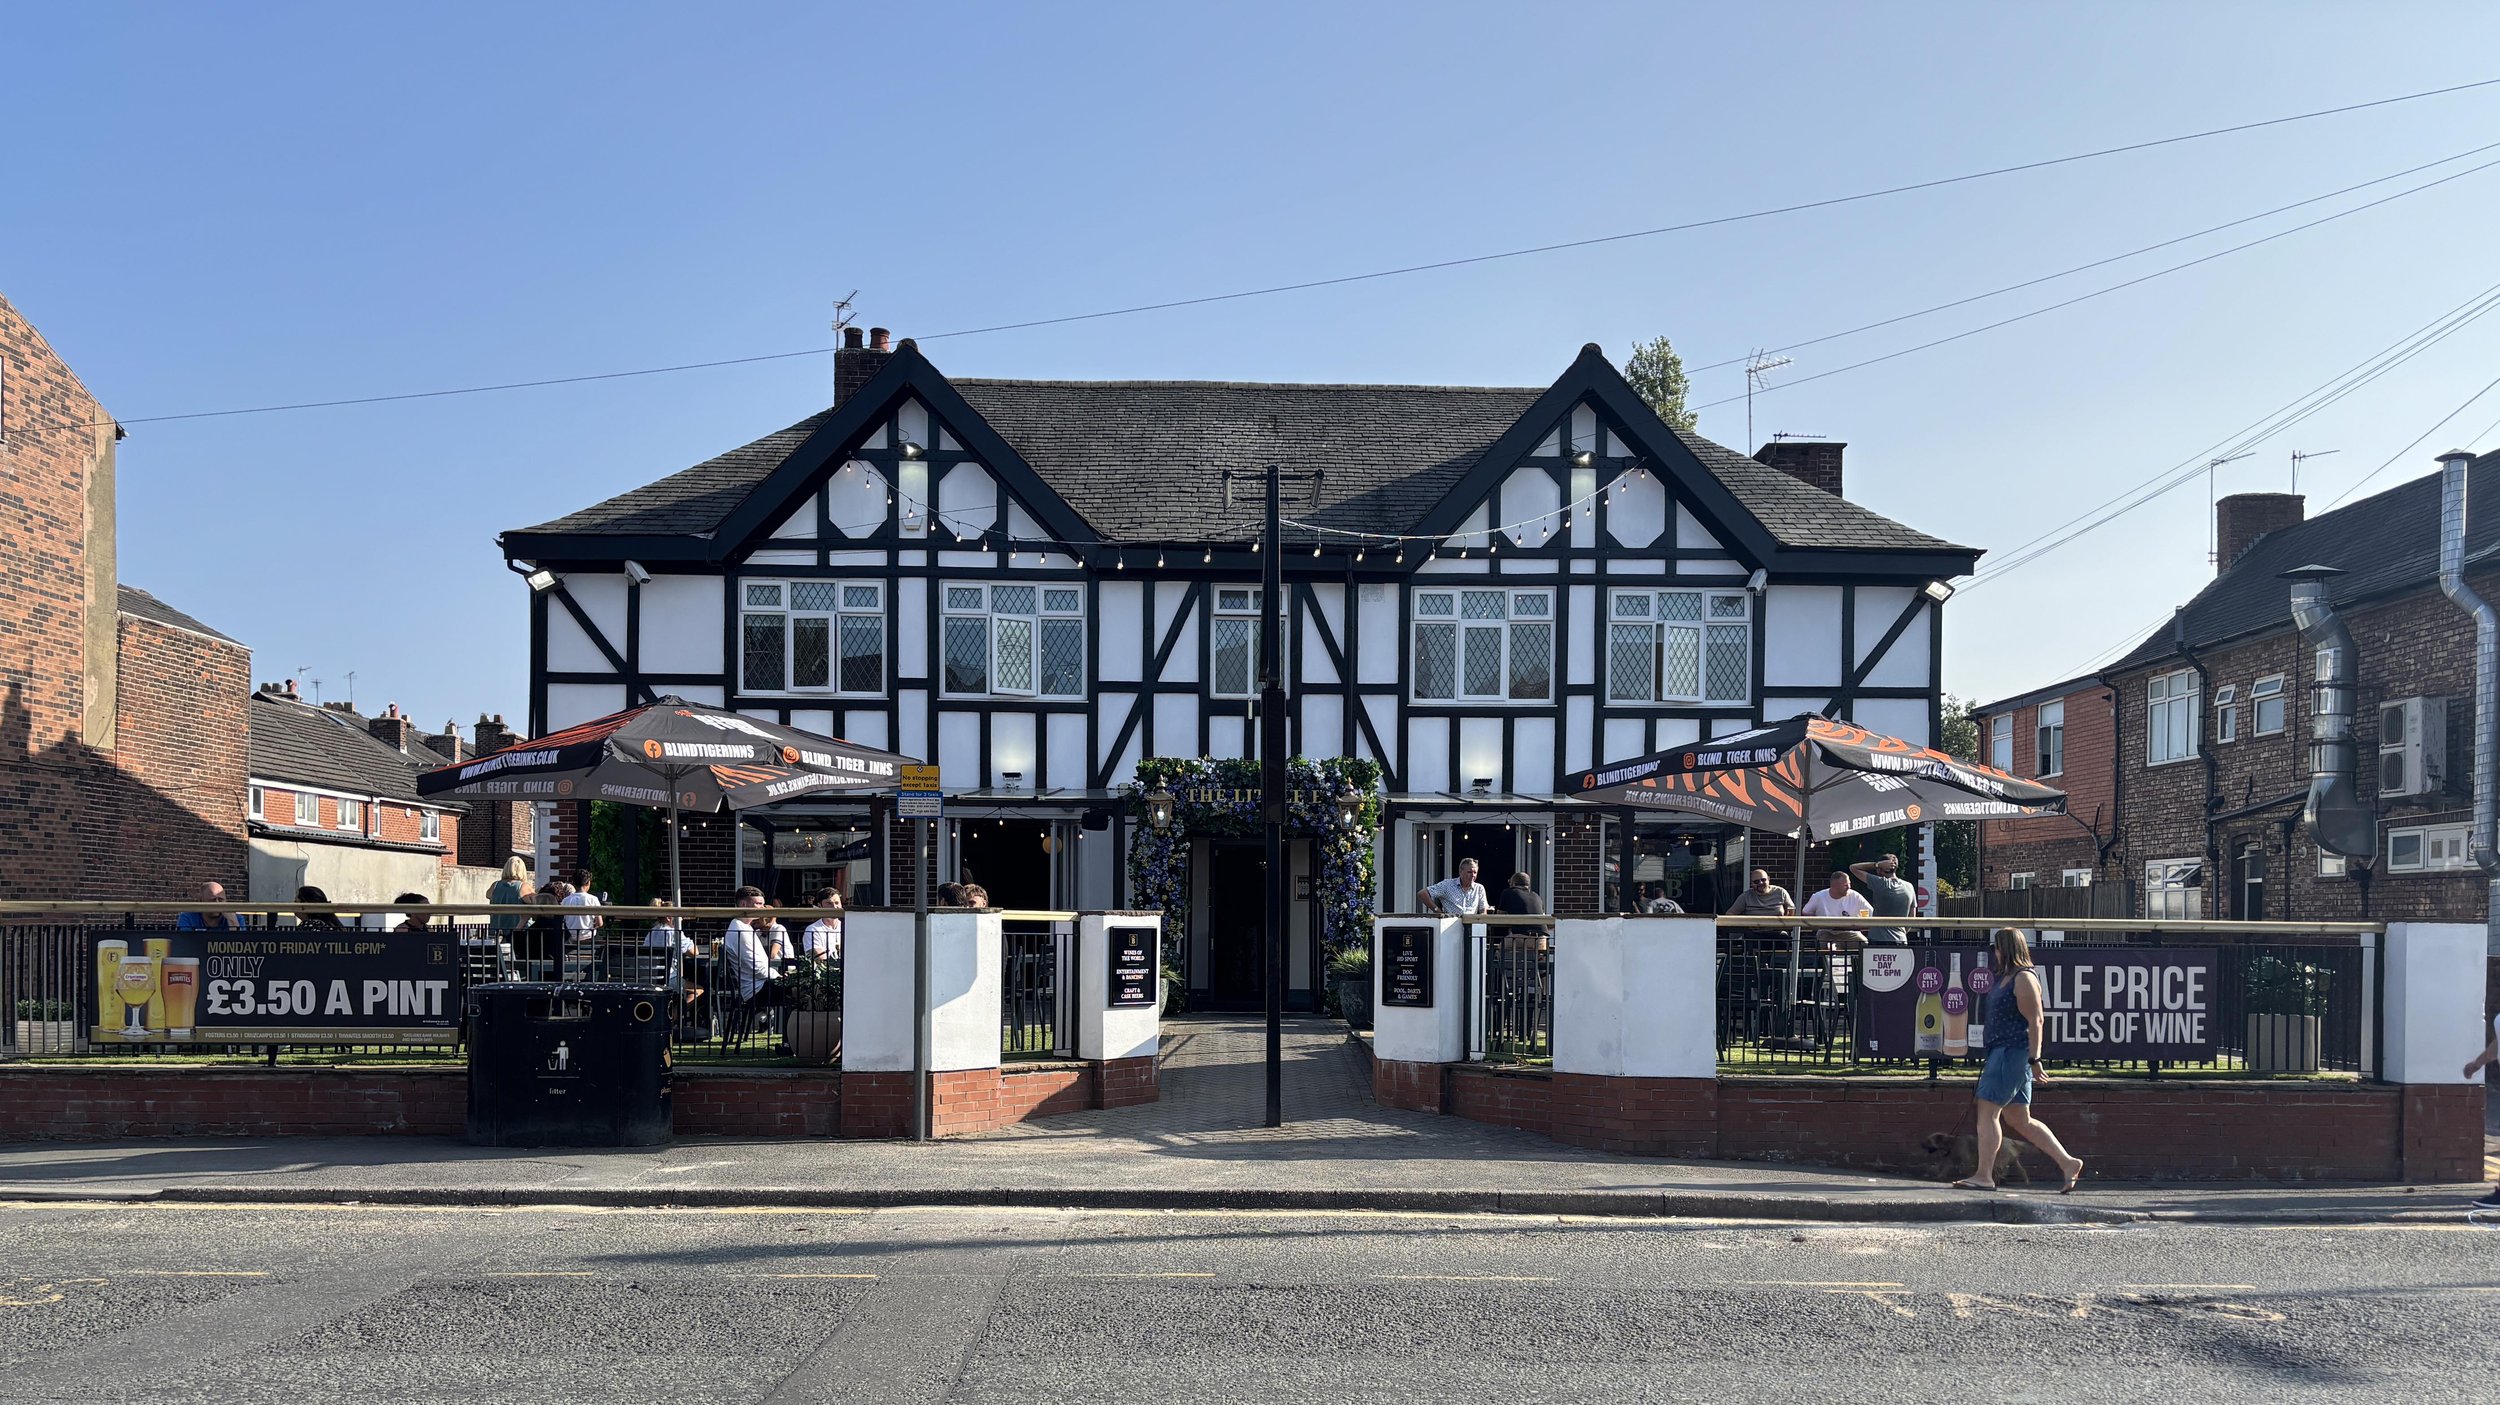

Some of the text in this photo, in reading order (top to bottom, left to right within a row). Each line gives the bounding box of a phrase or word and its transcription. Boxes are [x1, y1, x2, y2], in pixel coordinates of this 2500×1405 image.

[663, 742, 755, 758] BLINDTIGERINNS
[1597, 760, 1660, 786] BLINDTIGERINNS
[1186, 788, 1226, 803] THE
[207, 941, 259, 954] MONDAY
[261, 942, 277, 954] TO
[279, 942, 322, 954] FRIDAY
[1873, 954, 1897, 962] EVERY
[207, 956, 264, 978] ONLY
[1884, 969, 1901, 977] 6PM
[1922, 972, 1937, 980] ONLY
[1973, 973, 1989, 981] ONLY
[2034, 965, 2206, 1010] ALF PRICE
[207, 979, 448, 1015] £3.50 A PINT
[1948, 993, 1963, 1001] ONLY
[2110, 1012, 2140, 1043] OF
[2145, 1012, 2206, 1044] WINE
